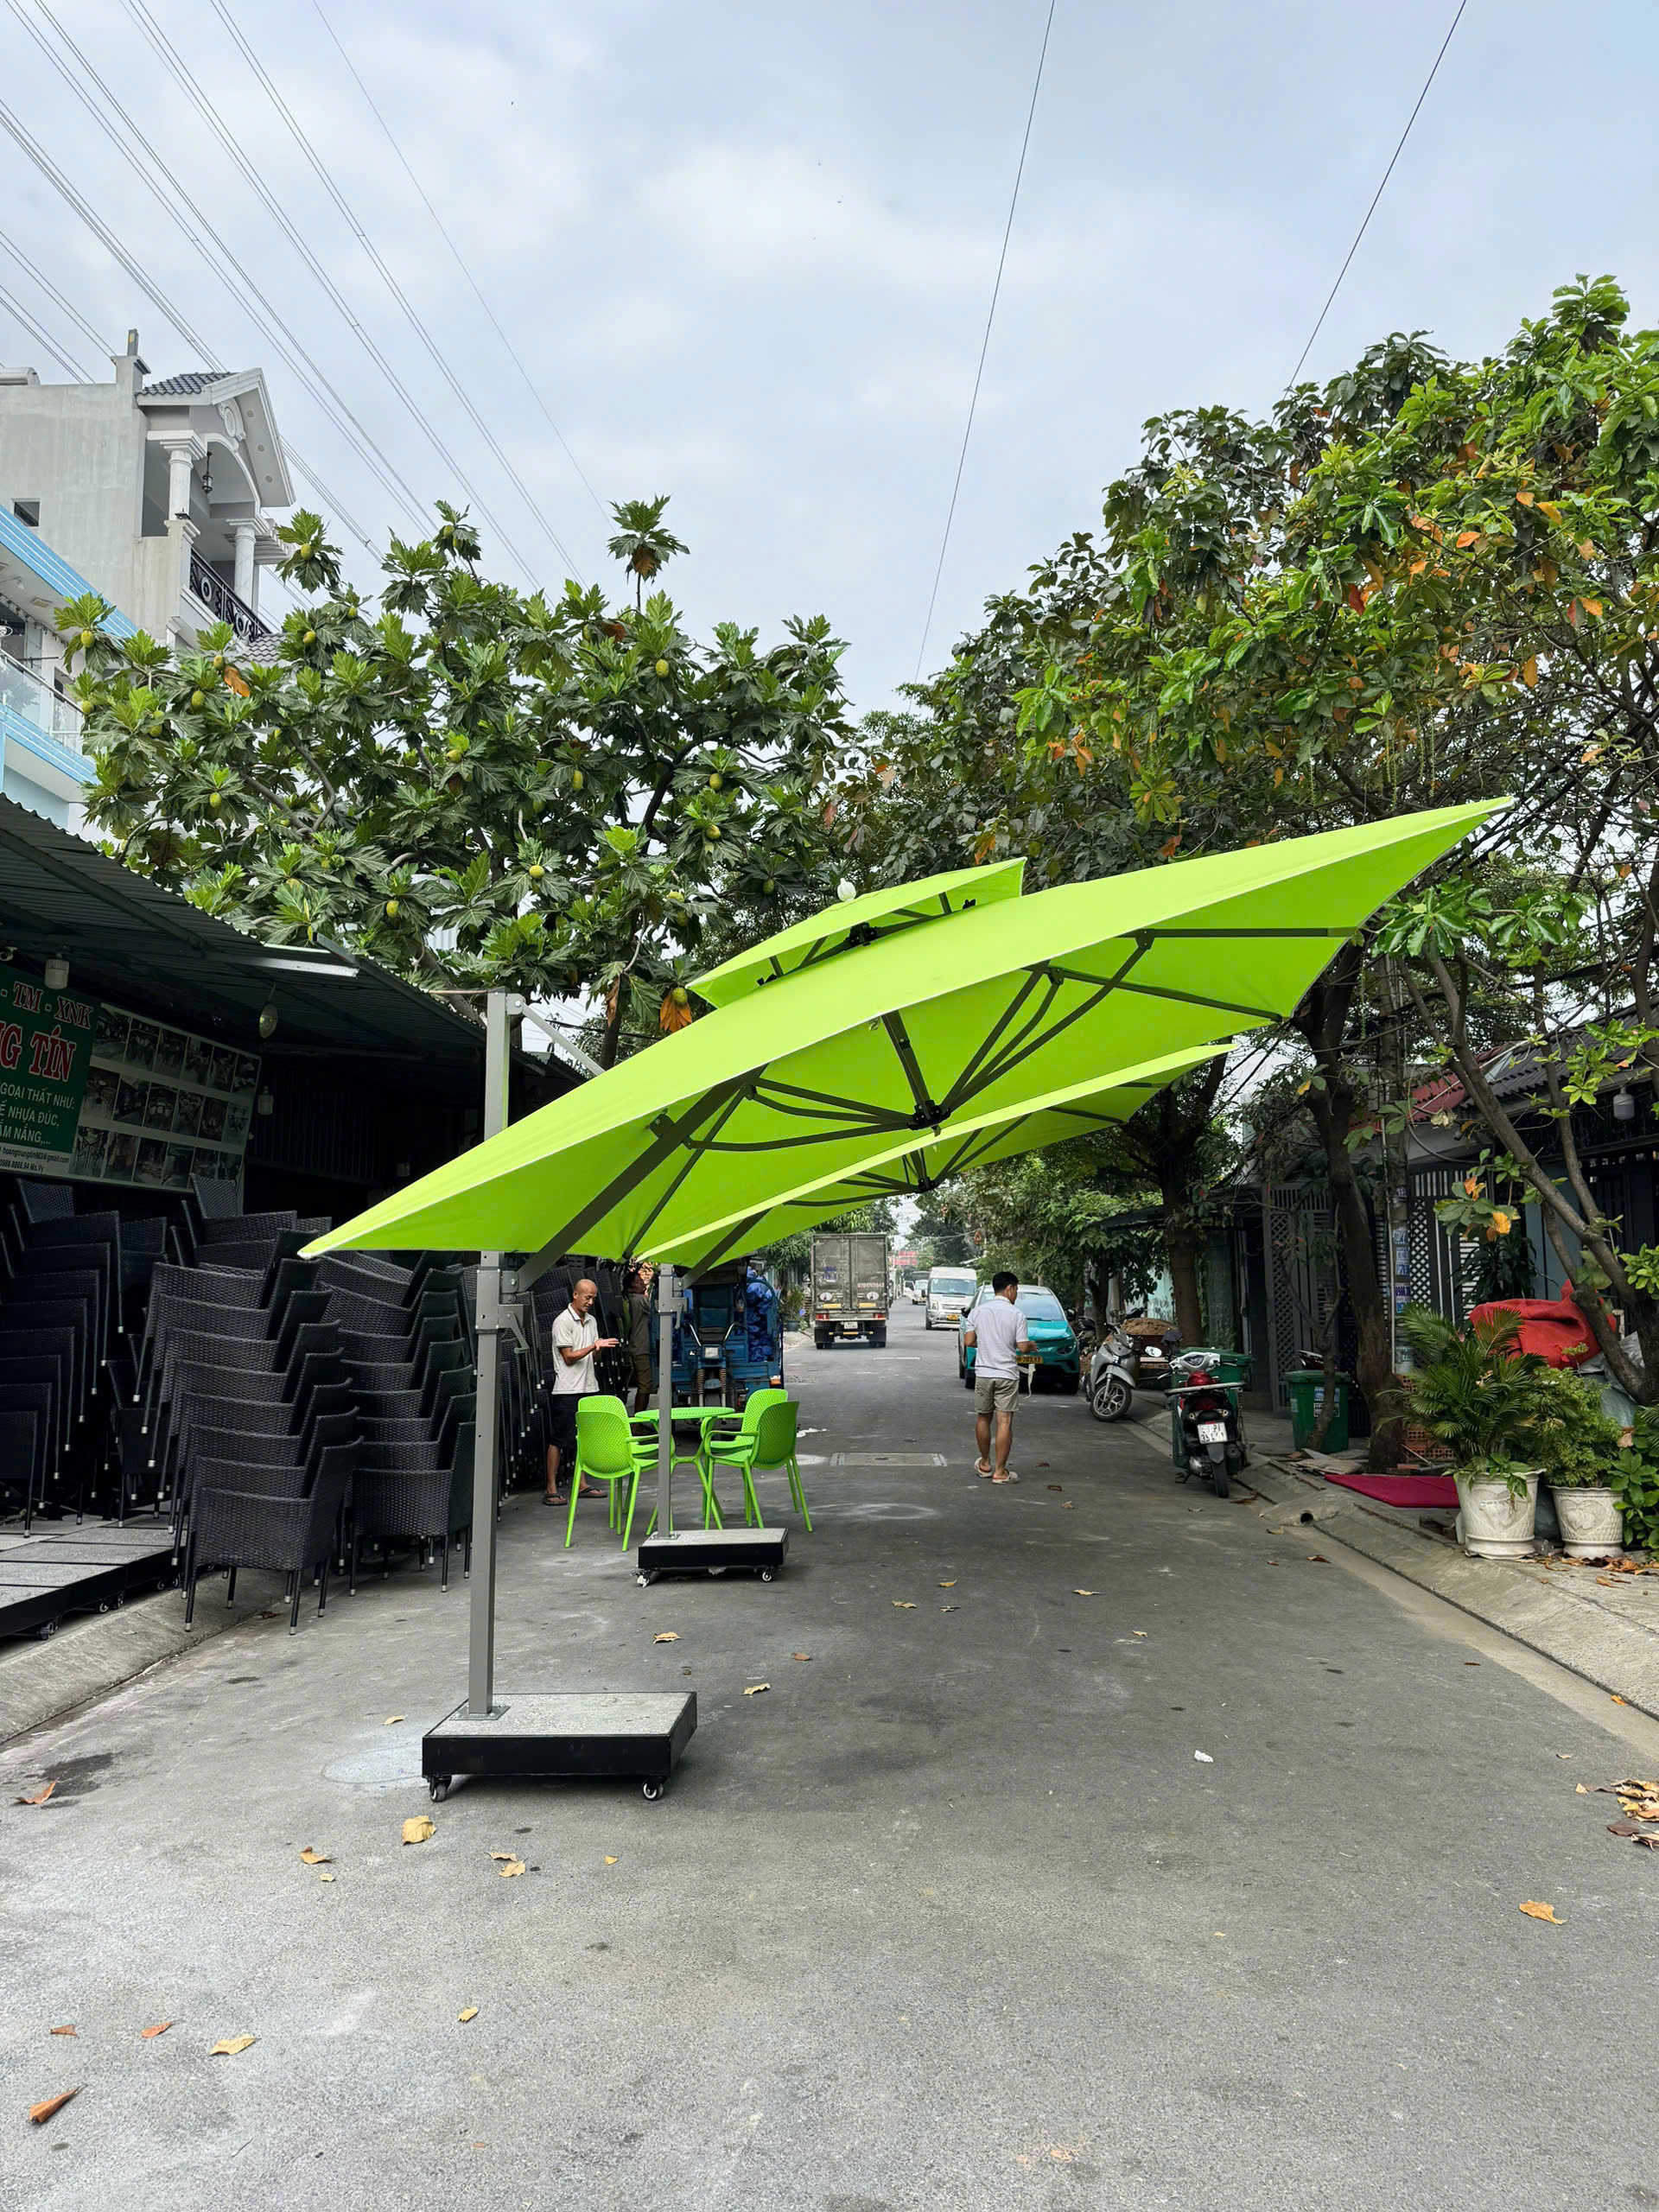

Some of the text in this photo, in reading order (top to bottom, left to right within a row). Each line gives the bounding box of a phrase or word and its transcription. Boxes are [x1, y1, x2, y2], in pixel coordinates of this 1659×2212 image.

[13, 982, 43, 1014] TM
[54, 995, 94, 1029] XNK
[29, 1025, 77, 1082] TÍN
[0, 1082, 26, 1100] GOẠI
[27, 1086, 53, 1105] THẤT
[8, 1105, 35, 1123] NHỰA
[37, 1110, 60, 1128] ĐÚC,
